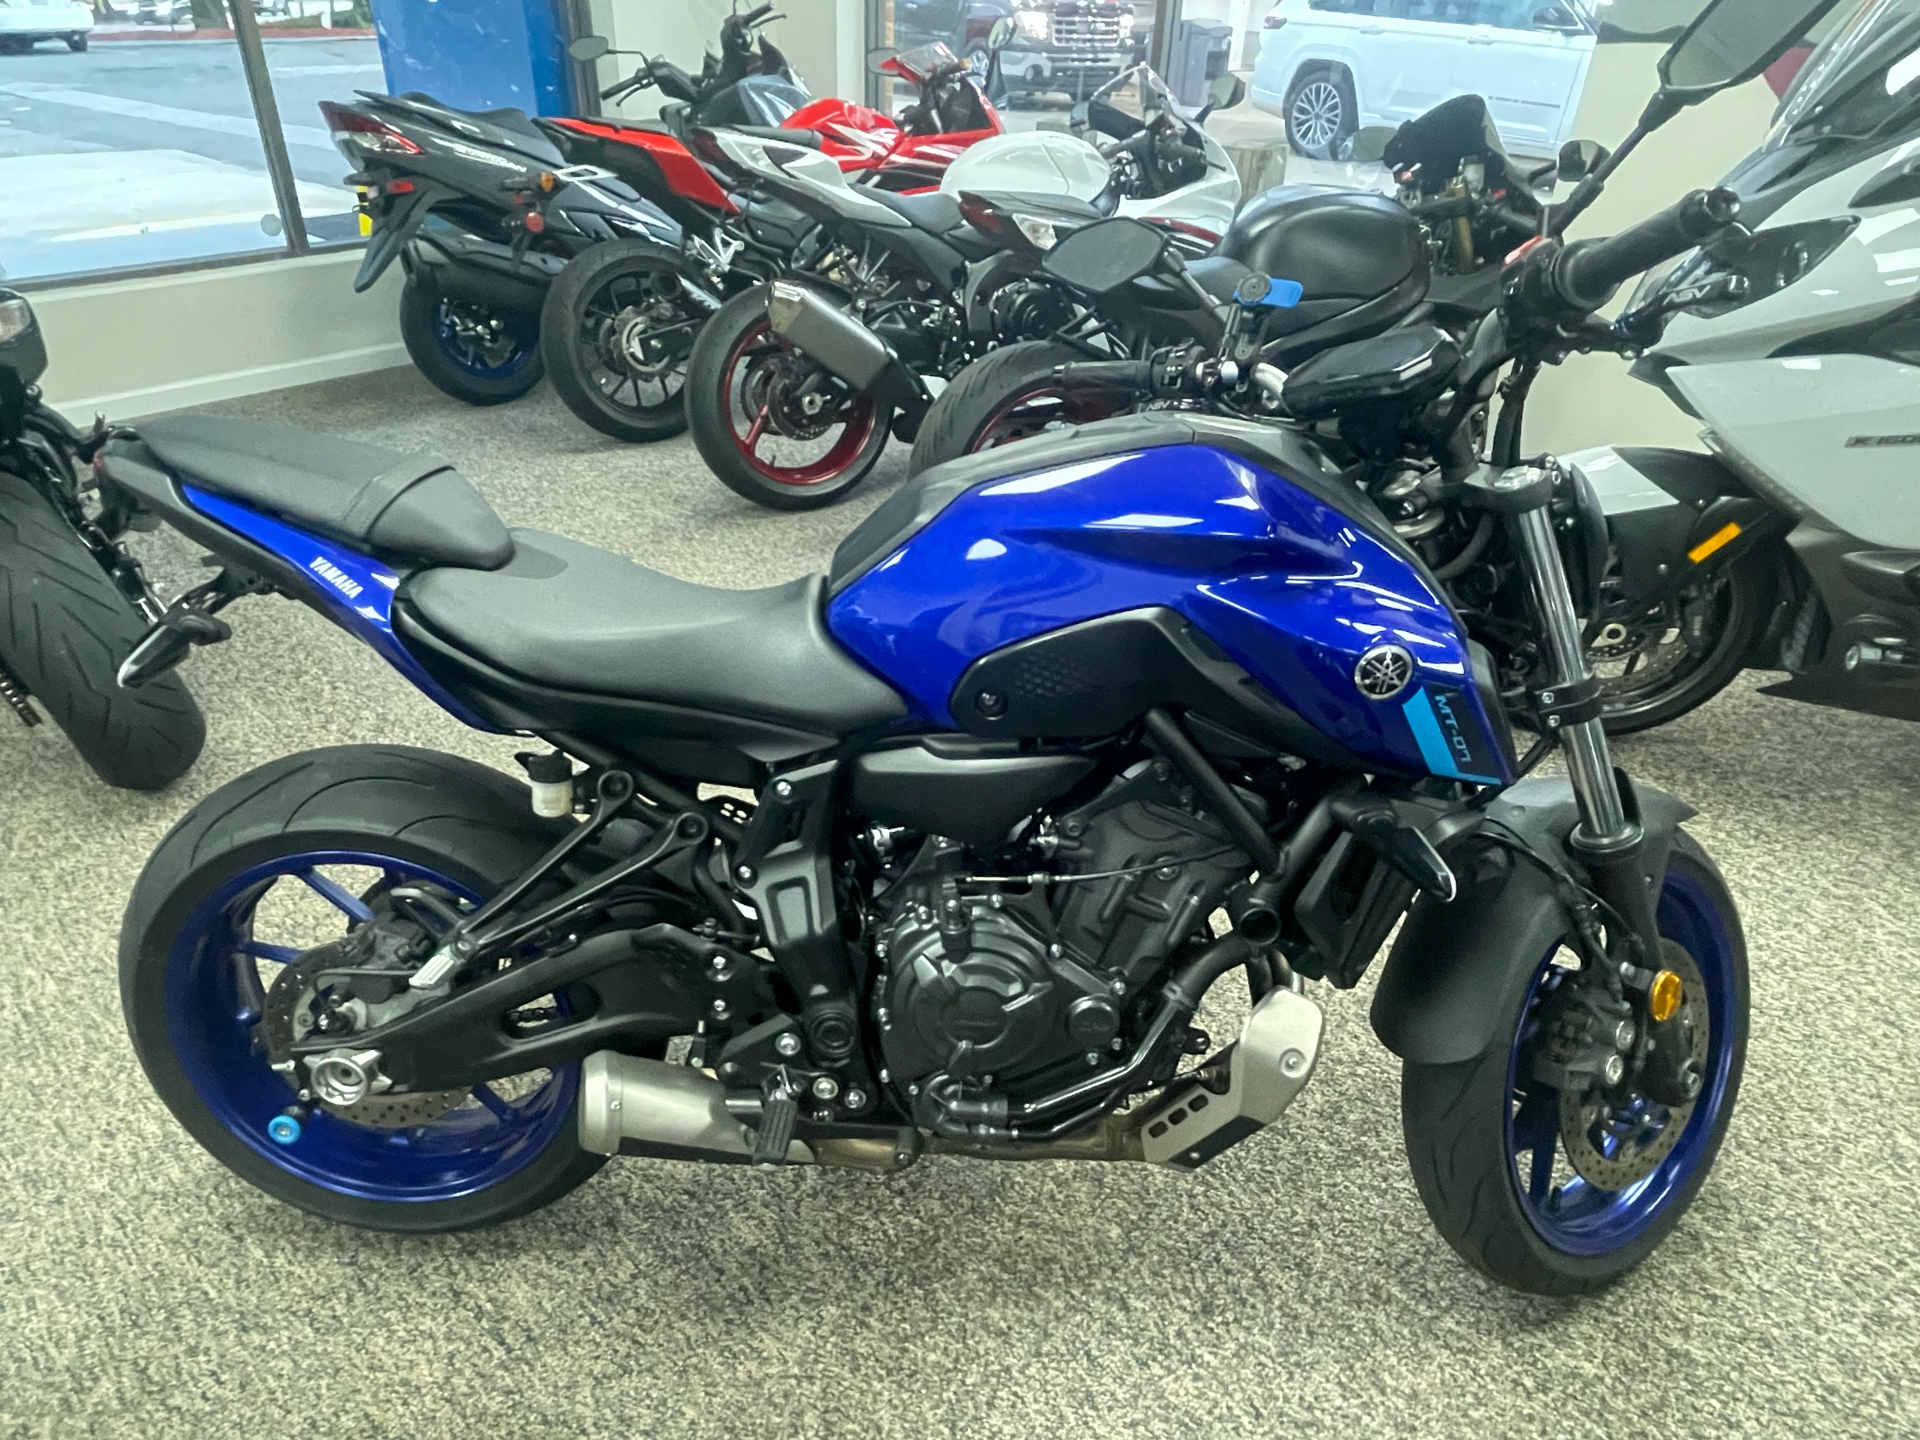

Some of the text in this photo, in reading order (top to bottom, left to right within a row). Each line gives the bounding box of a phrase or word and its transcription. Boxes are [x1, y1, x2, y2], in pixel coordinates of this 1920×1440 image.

[1662, 284, 1711, 306] ASV
[309, 556, 364, 599] YAMAHA
[1434, 695, 1472, 762] MT-07
